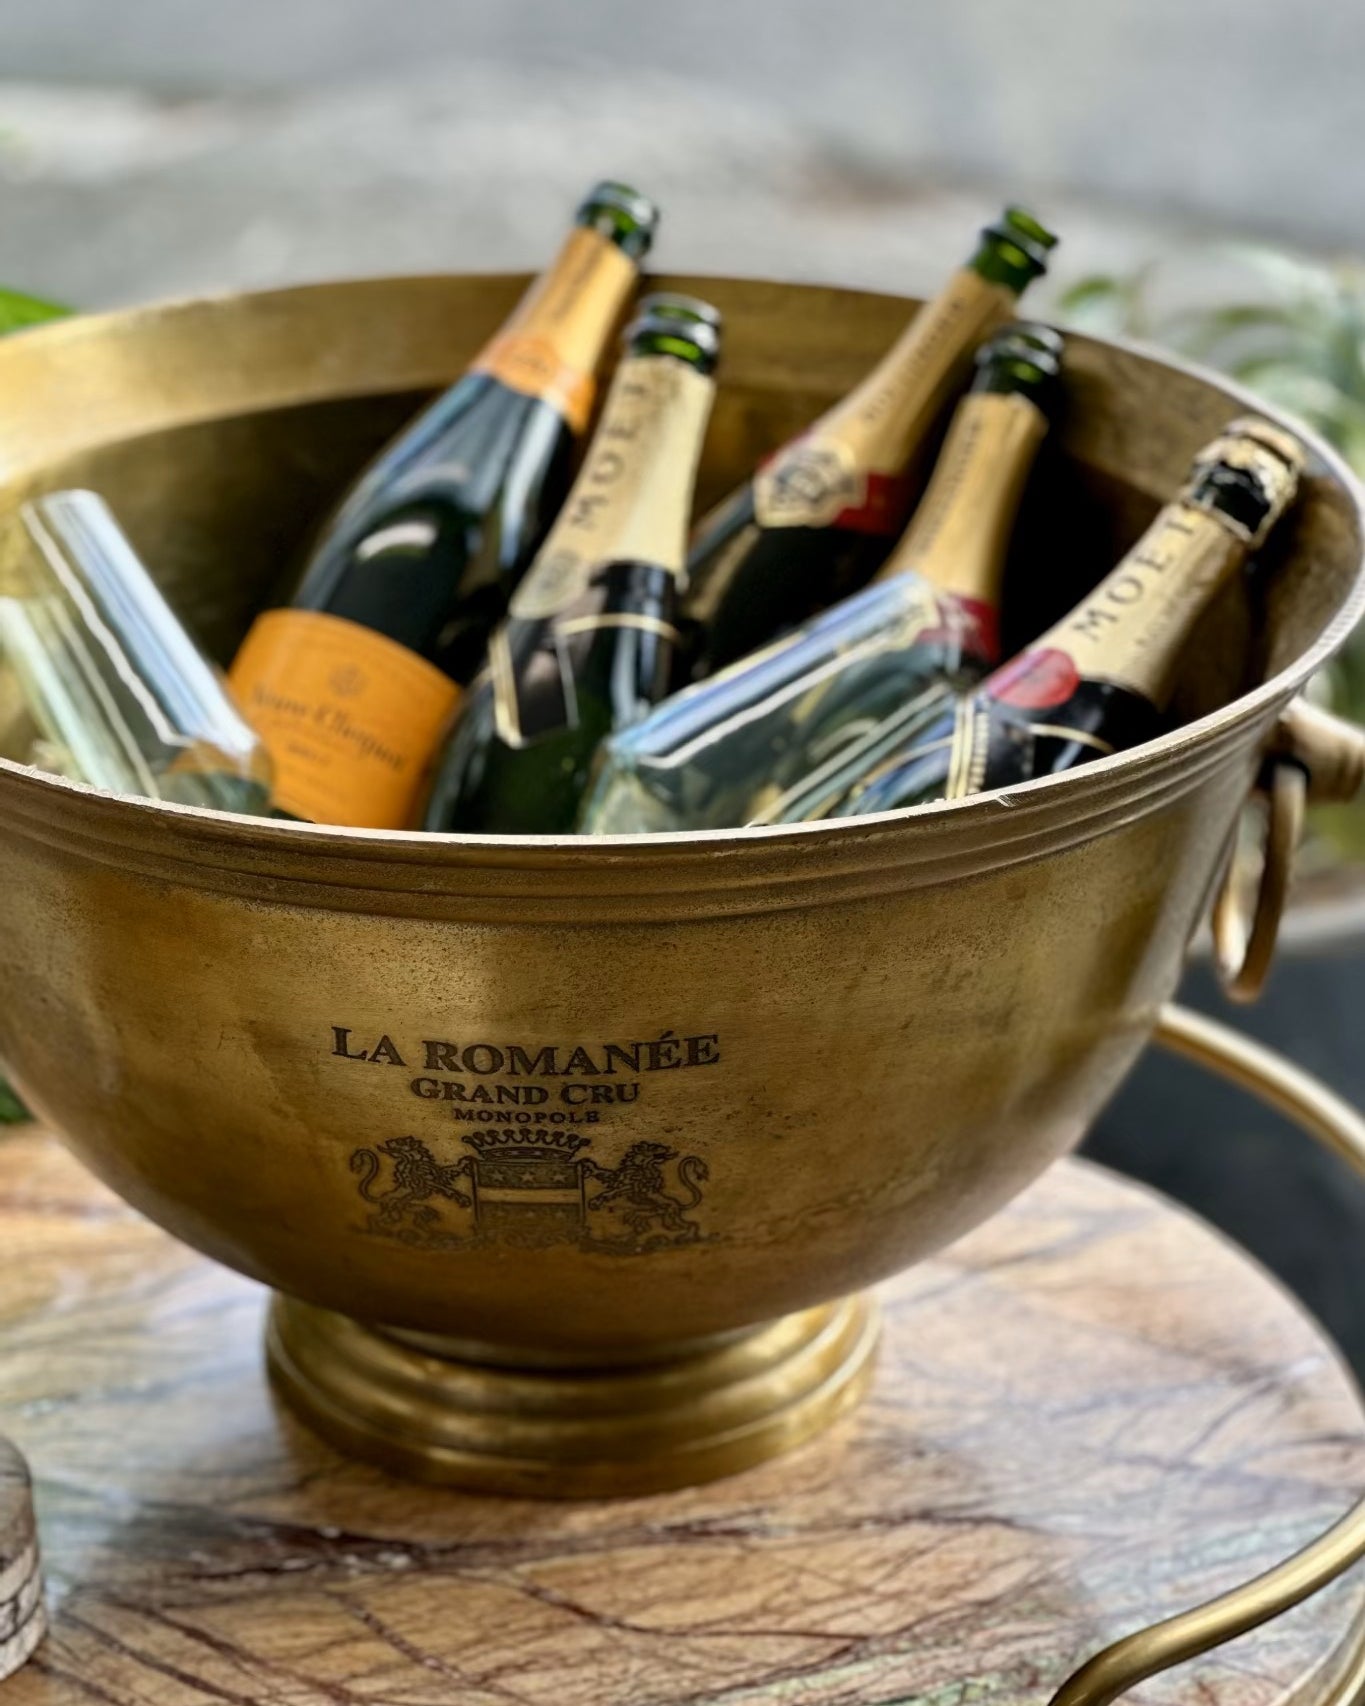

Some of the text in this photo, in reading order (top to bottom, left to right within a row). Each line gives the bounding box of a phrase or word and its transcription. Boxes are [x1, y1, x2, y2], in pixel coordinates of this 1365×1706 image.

[331, 1026, 720, 1076] LA ROMANÉE
[410, 1077, 640, 1106] GRAND CRU
[454, 1107, 600, 1124] MONOPOLE
